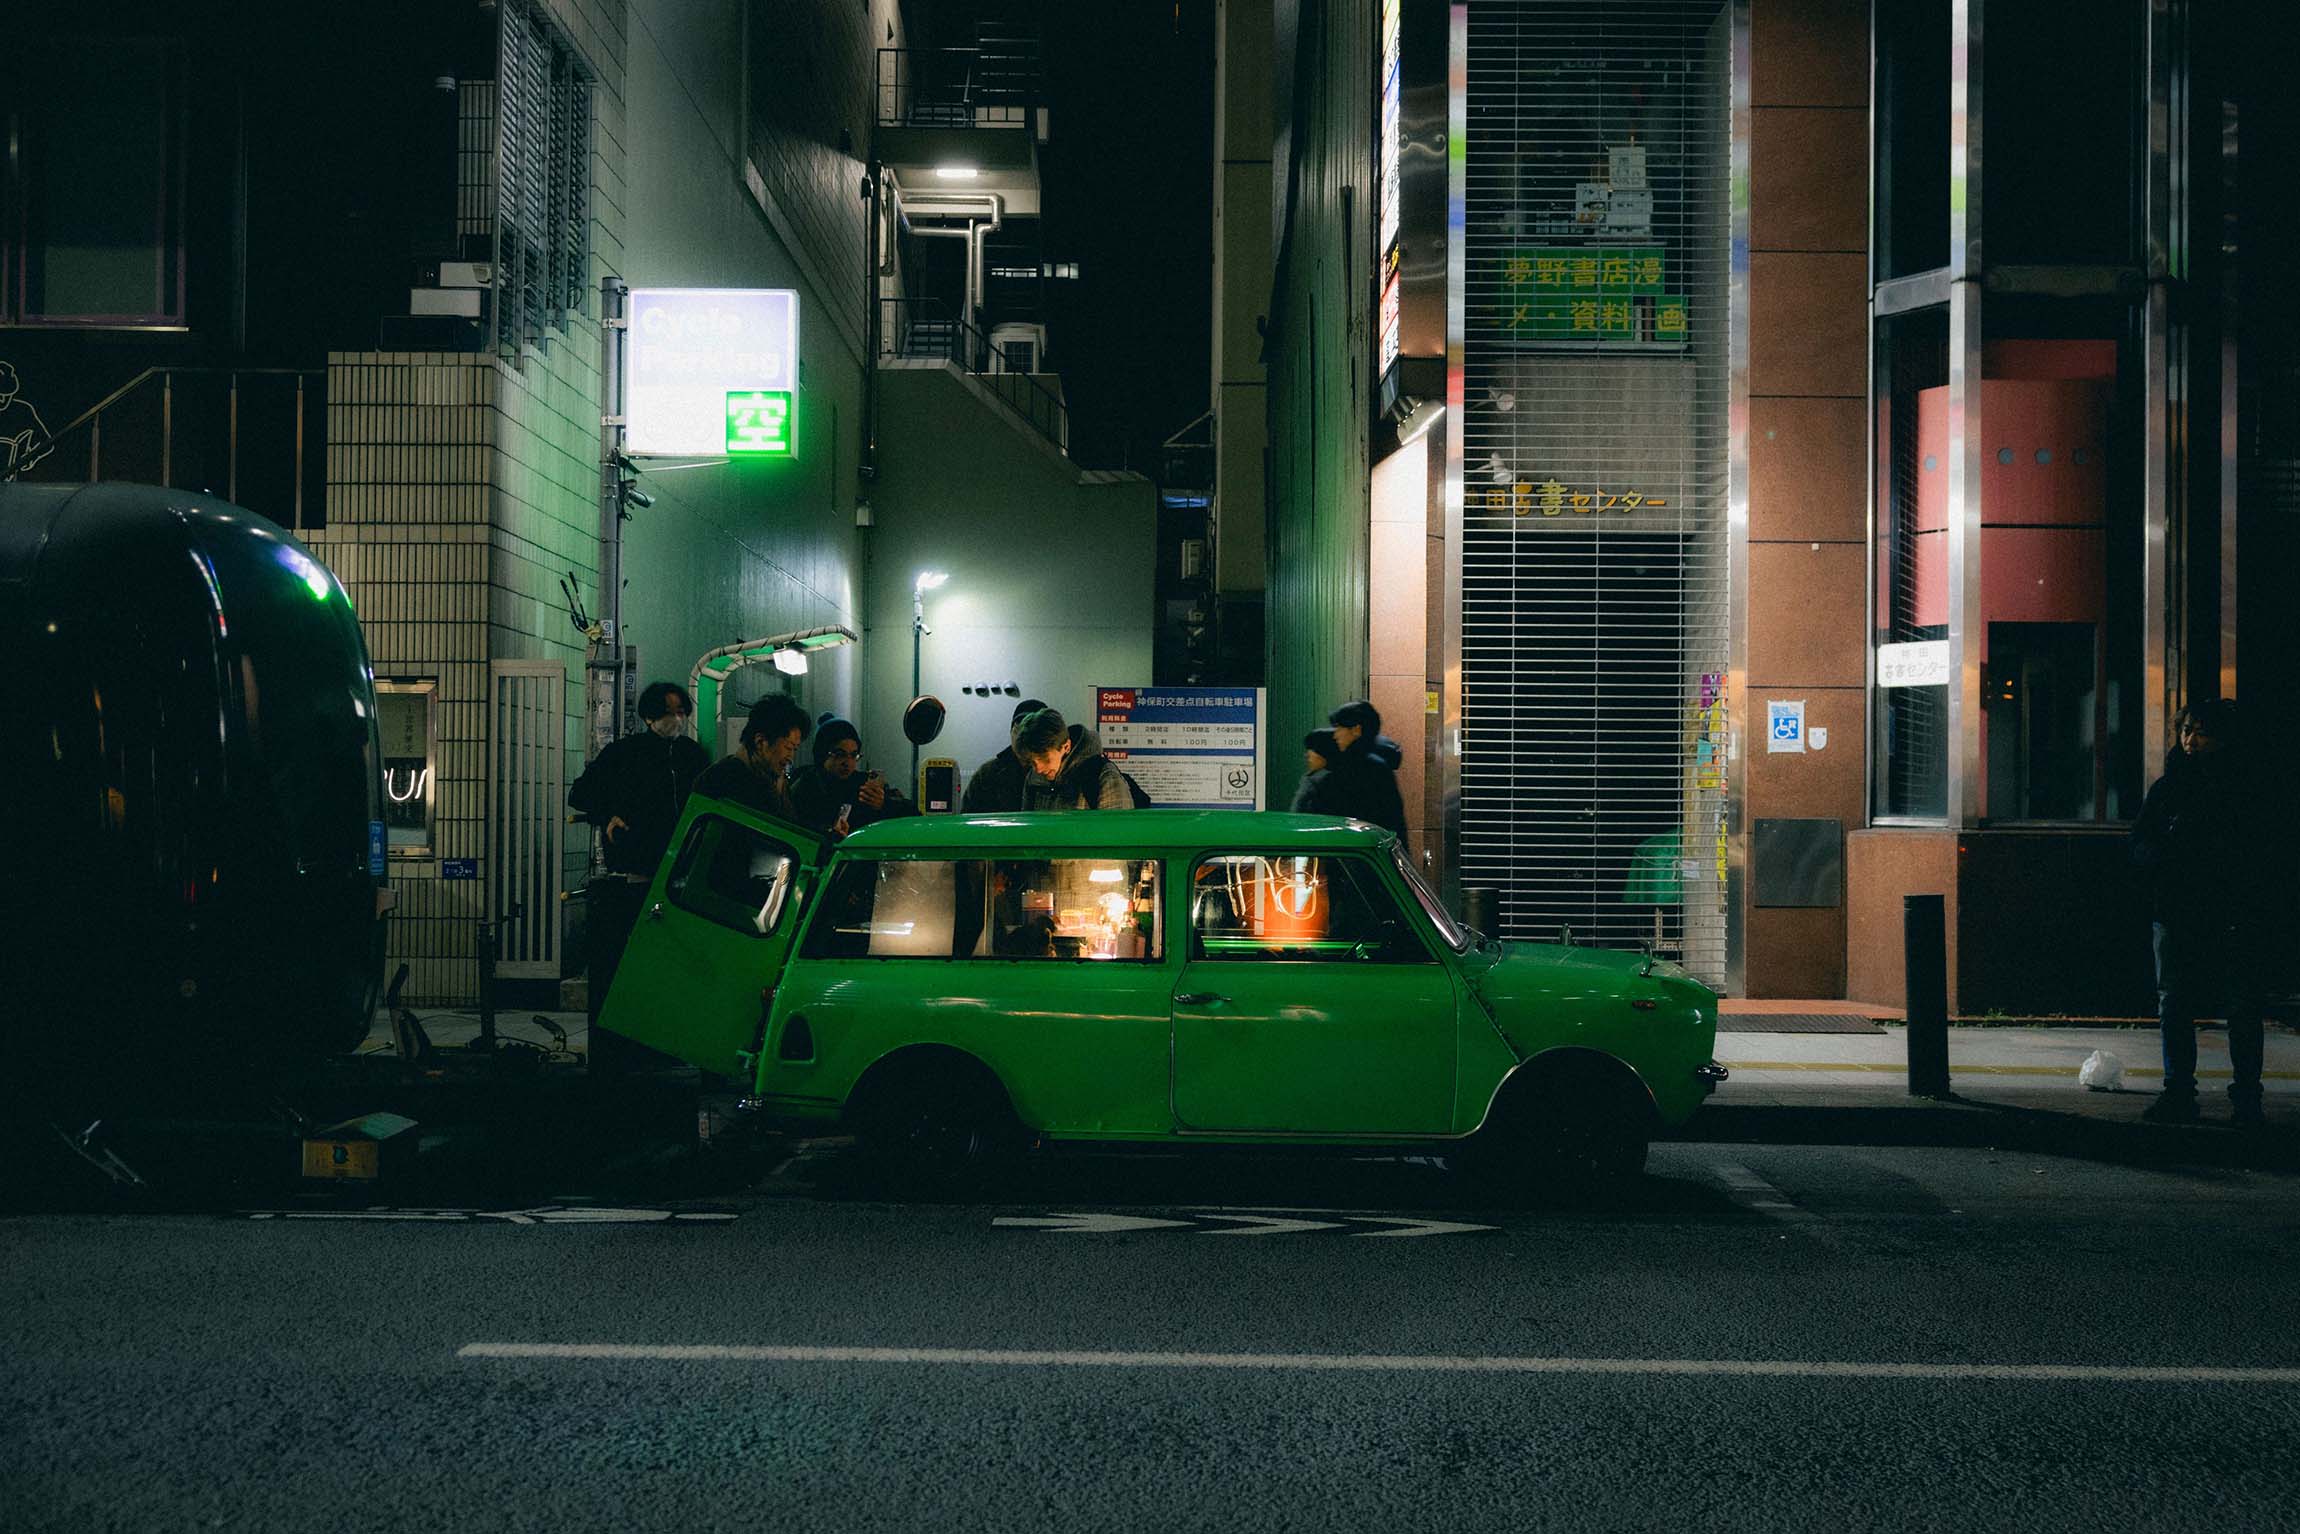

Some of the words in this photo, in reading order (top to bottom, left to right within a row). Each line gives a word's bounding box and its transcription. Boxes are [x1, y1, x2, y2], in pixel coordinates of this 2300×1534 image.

[1504, 256, 1663, 287] 夢野書店漫
[1658, 303, 1687, 332] 画
[729, 393, 785, 449] 空
[1103, 692, 1124, 701] Cycle
[1103, 700, 1132, 709] Parking
[1137, 696, 1254, 708] 神保町交差点自転車駐車場
